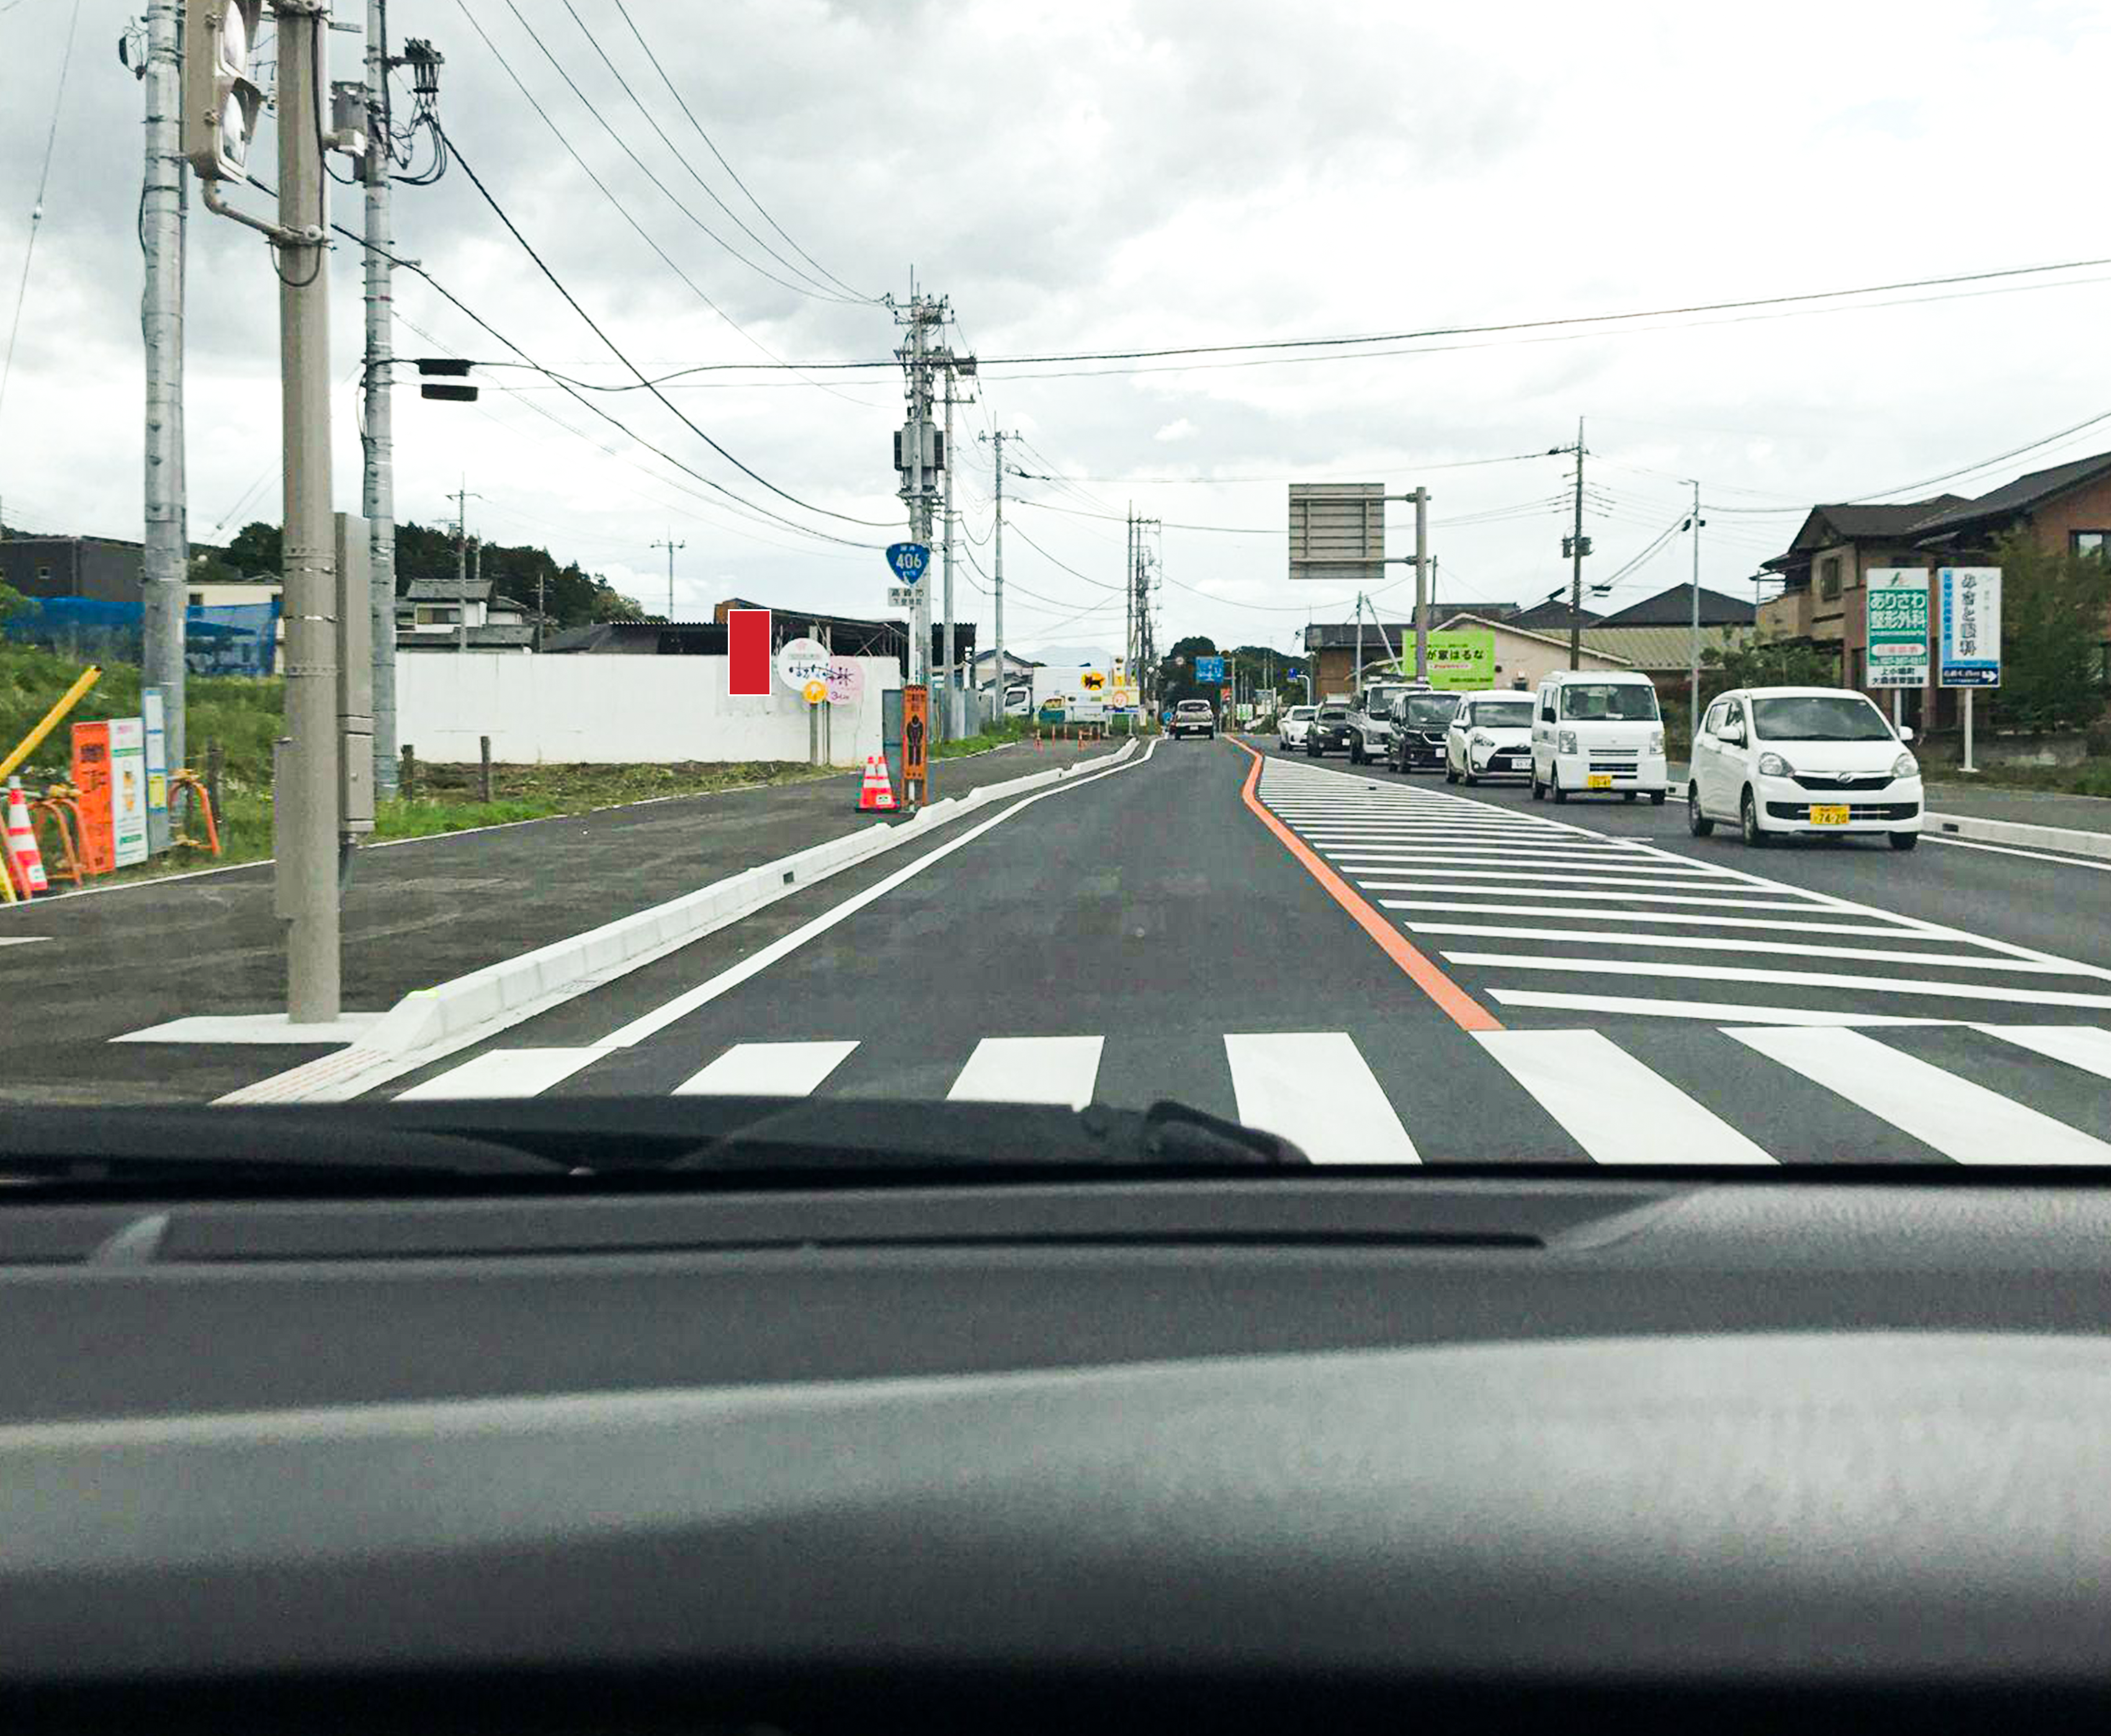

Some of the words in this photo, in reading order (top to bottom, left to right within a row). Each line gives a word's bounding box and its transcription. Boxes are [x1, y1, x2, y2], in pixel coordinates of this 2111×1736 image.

[896, 553, 922, 569] 406
[1870, 593, 1925, 609] ありさわ
[1871, 610, 1925, 629] 整形外科
[1426, 650, 1484, 660] が家はるな
